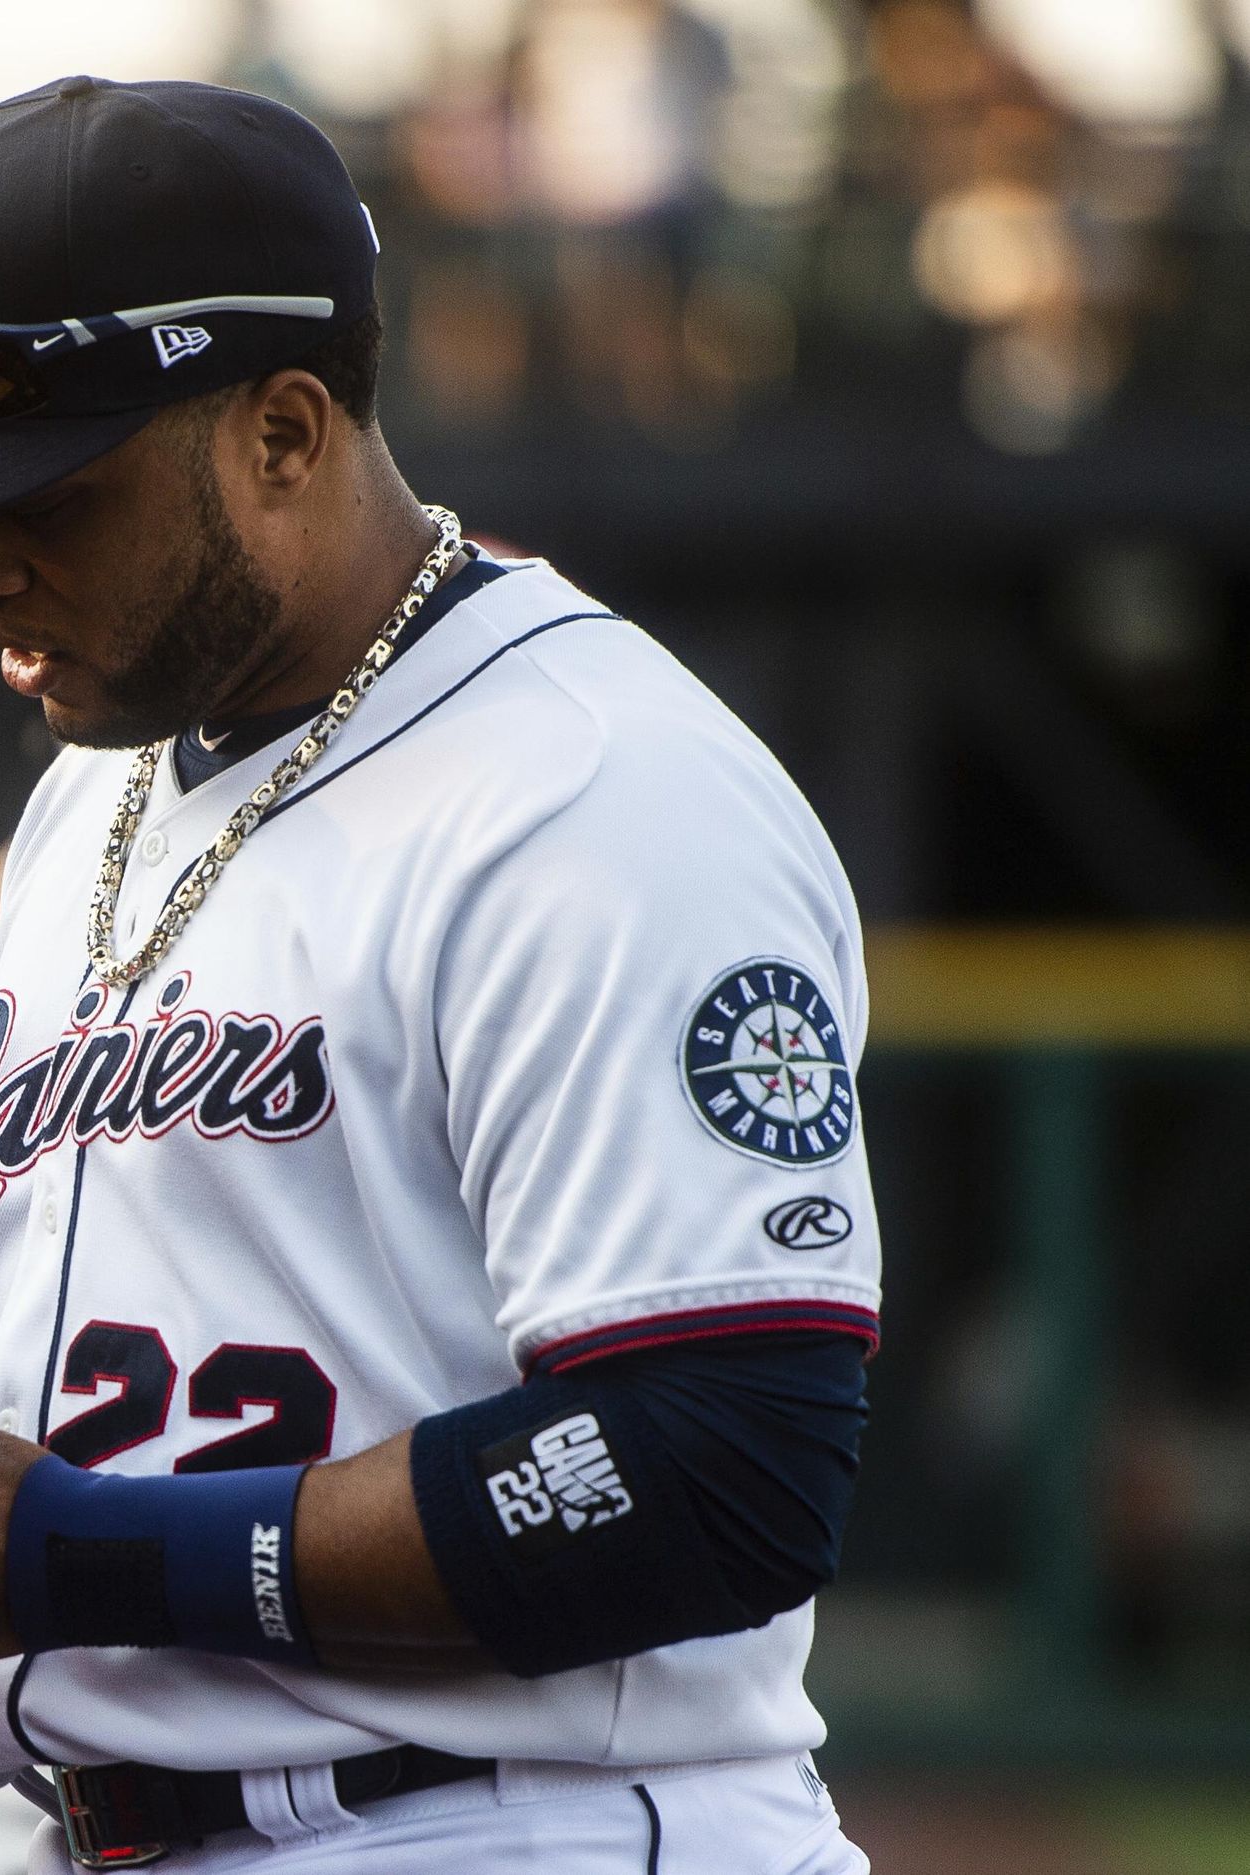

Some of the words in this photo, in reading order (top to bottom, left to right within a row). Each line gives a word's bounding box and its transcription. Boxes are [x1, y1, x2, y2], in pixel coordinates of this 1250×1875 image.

[698, 969, 837, 1045] SEATTLE
[707, 1084, 851, 1156] MARINERS
[44, 1319, 338, 1476] 22
[486, 1460, 554, 1537] 22
[251, 1521, 295, 1643] BENIK
